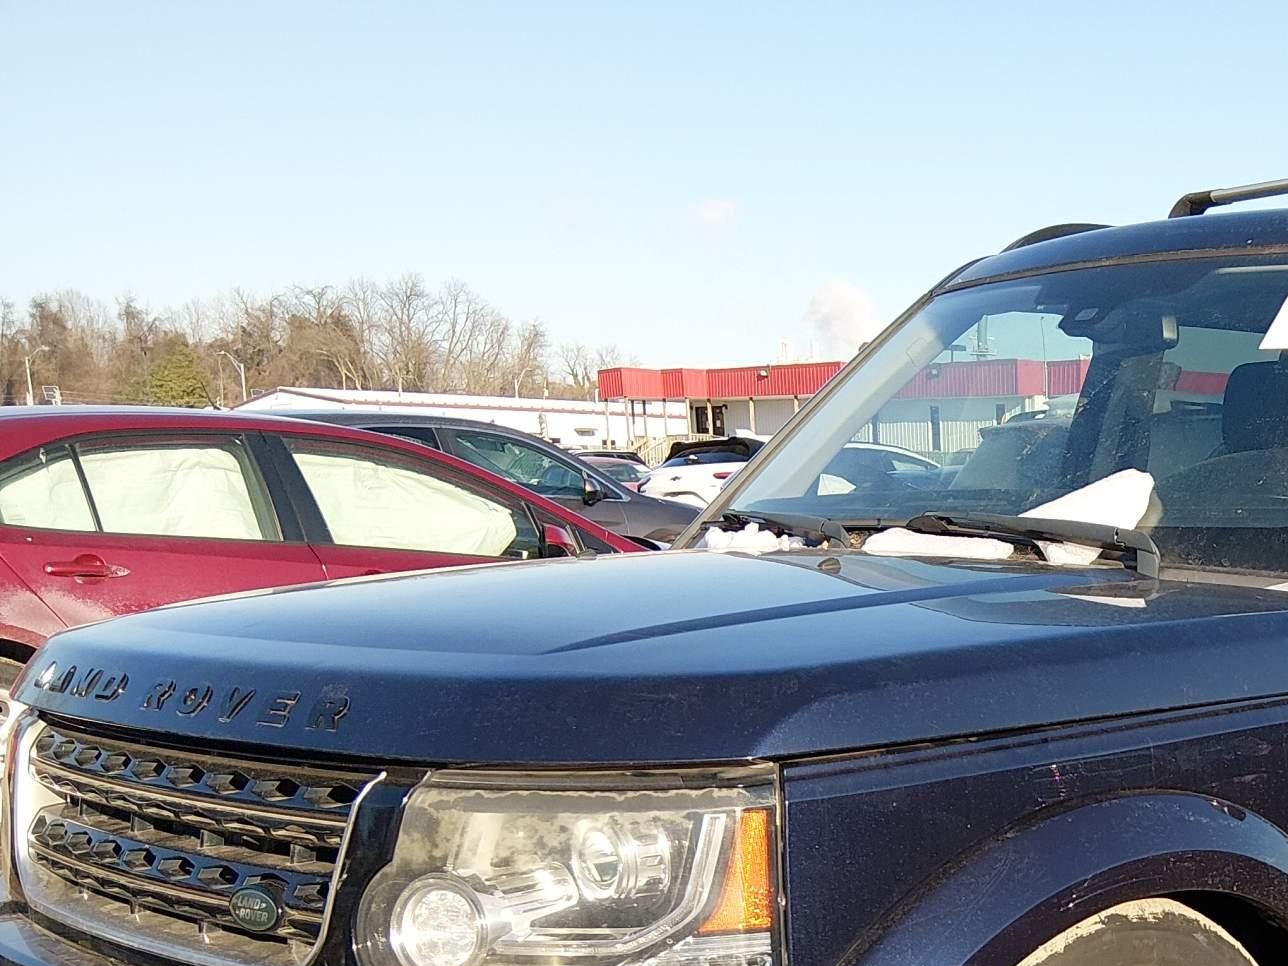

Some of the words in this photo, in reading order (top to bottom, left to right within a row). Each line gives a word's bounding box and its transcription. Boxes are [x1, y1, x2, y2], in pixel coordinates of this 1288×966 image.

[34, 660, 129, 703] LAND
[139, 679, 351, 732] ROVER
[238, 896, 262, 910] LAND
[240, 907, 268, 922] ROVER
